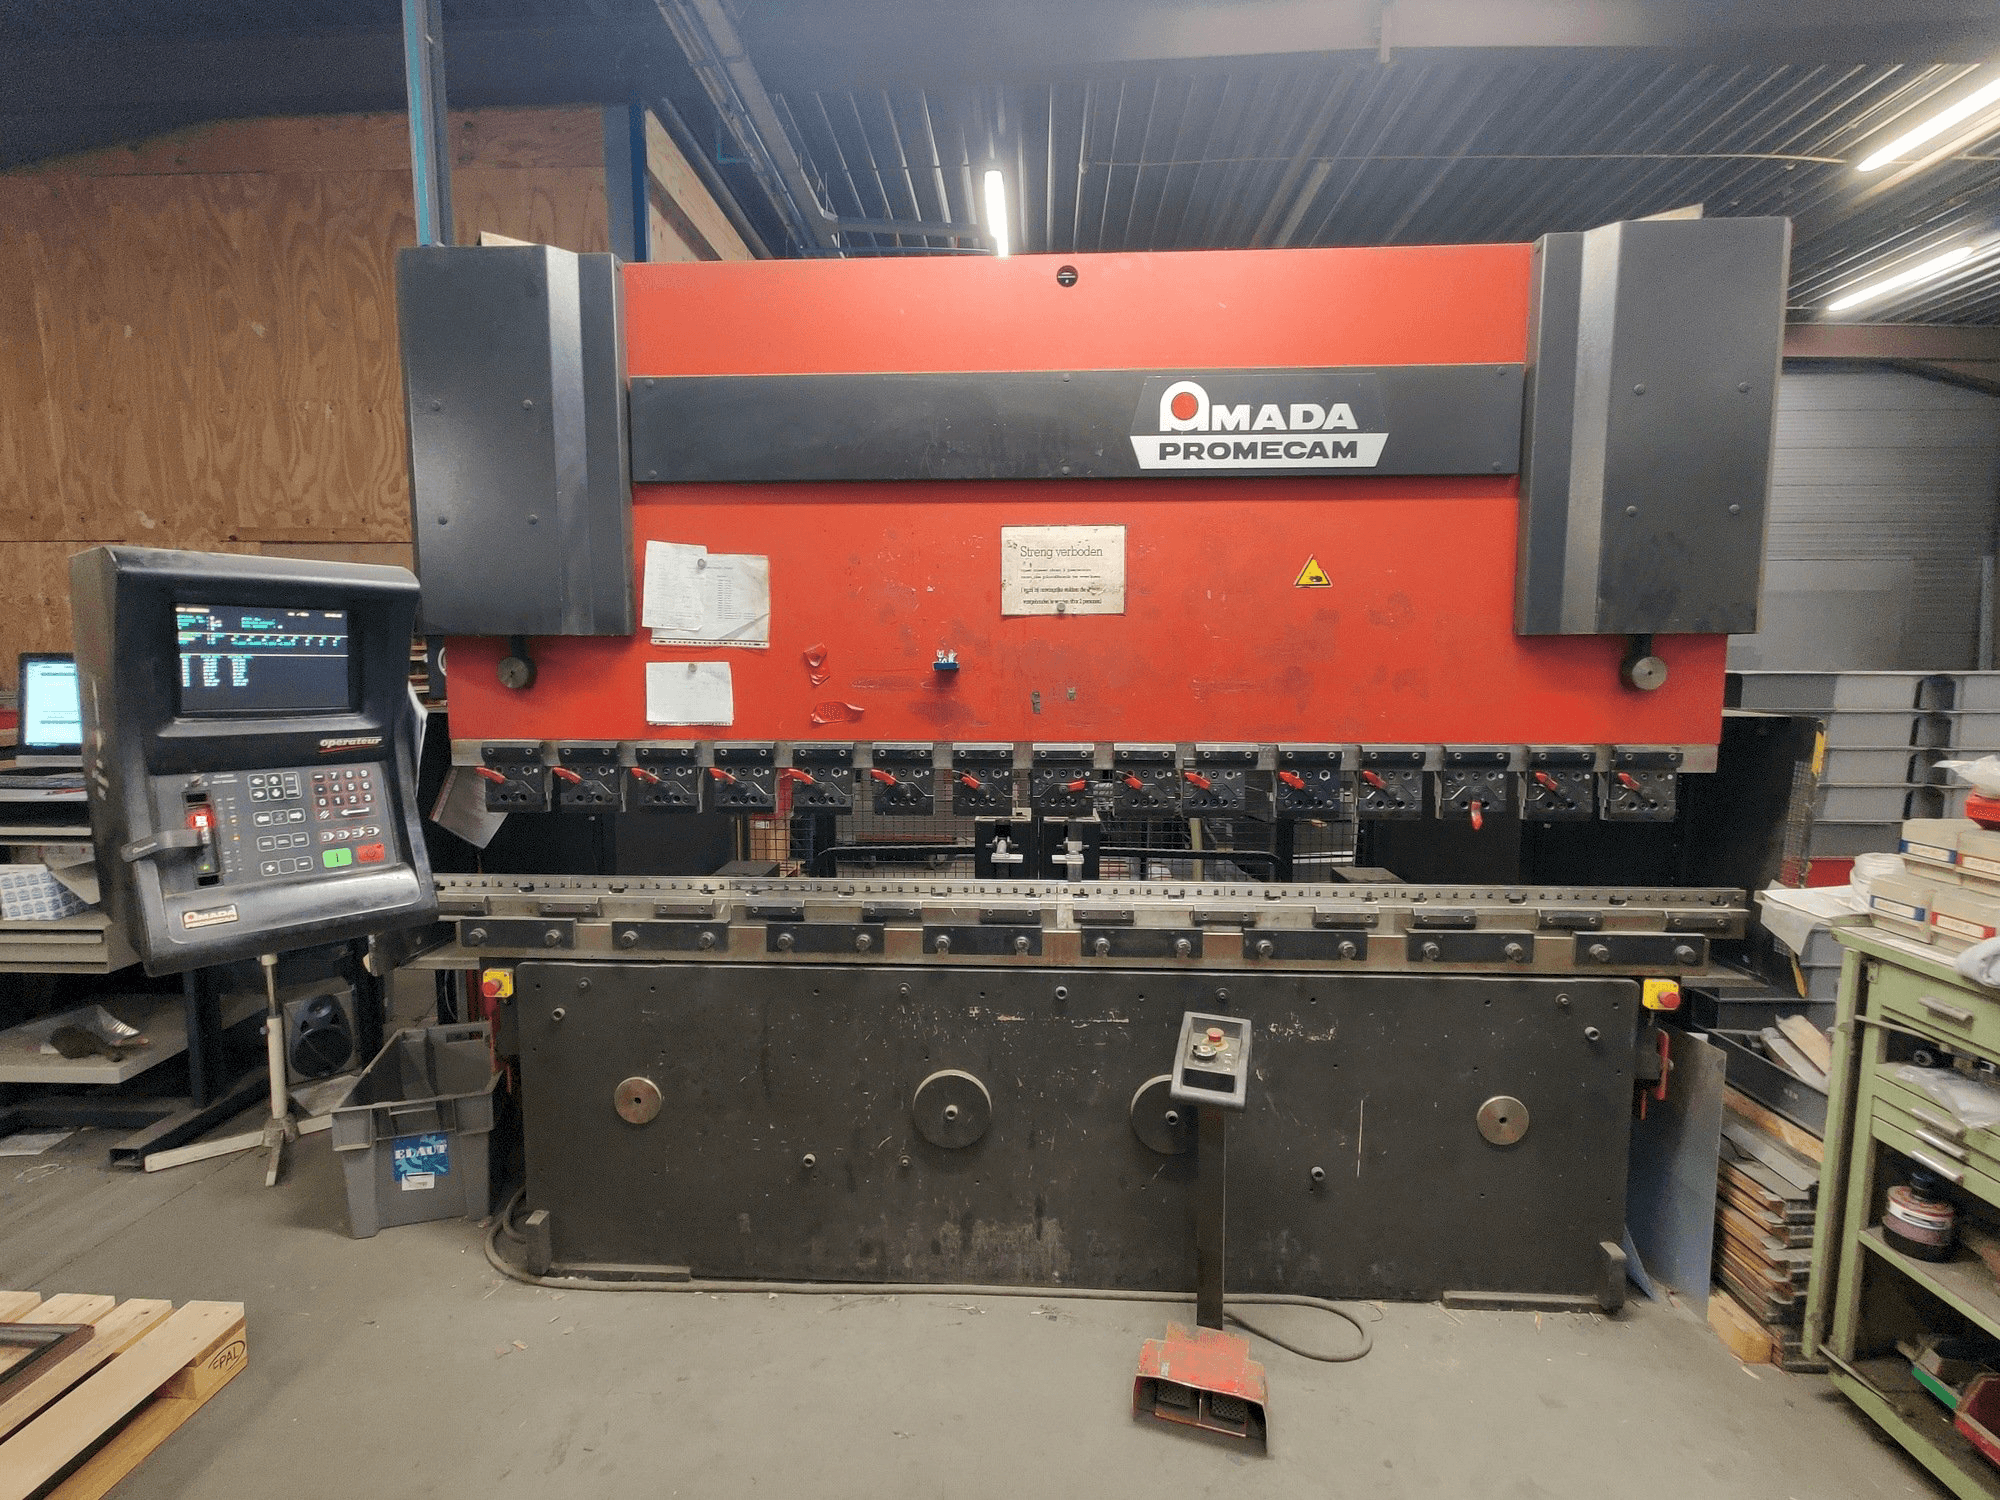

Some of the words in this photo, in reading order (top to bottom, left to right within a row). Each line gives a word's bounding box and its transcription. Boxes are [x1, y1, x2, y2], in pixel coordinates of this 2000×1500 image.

[1159, 380, 1359, 432] AMADA
[1158, 440, 1358, 461] PROMECAM
[1020, 545, 1053, 559] Streng
[1055, 545, 1103, 557] verboden
[320, 736, 382, 748] operateur
[346, 770, 353, 778] 8
[360, 769, 368, 777] 9
[348, 783, 355, 791] 5
[362, 782, 370, 790] 6
[319, 798, 326, 806] 0
[349, 795, 357, 803] 2
[364, 794, 371, 802] 3
